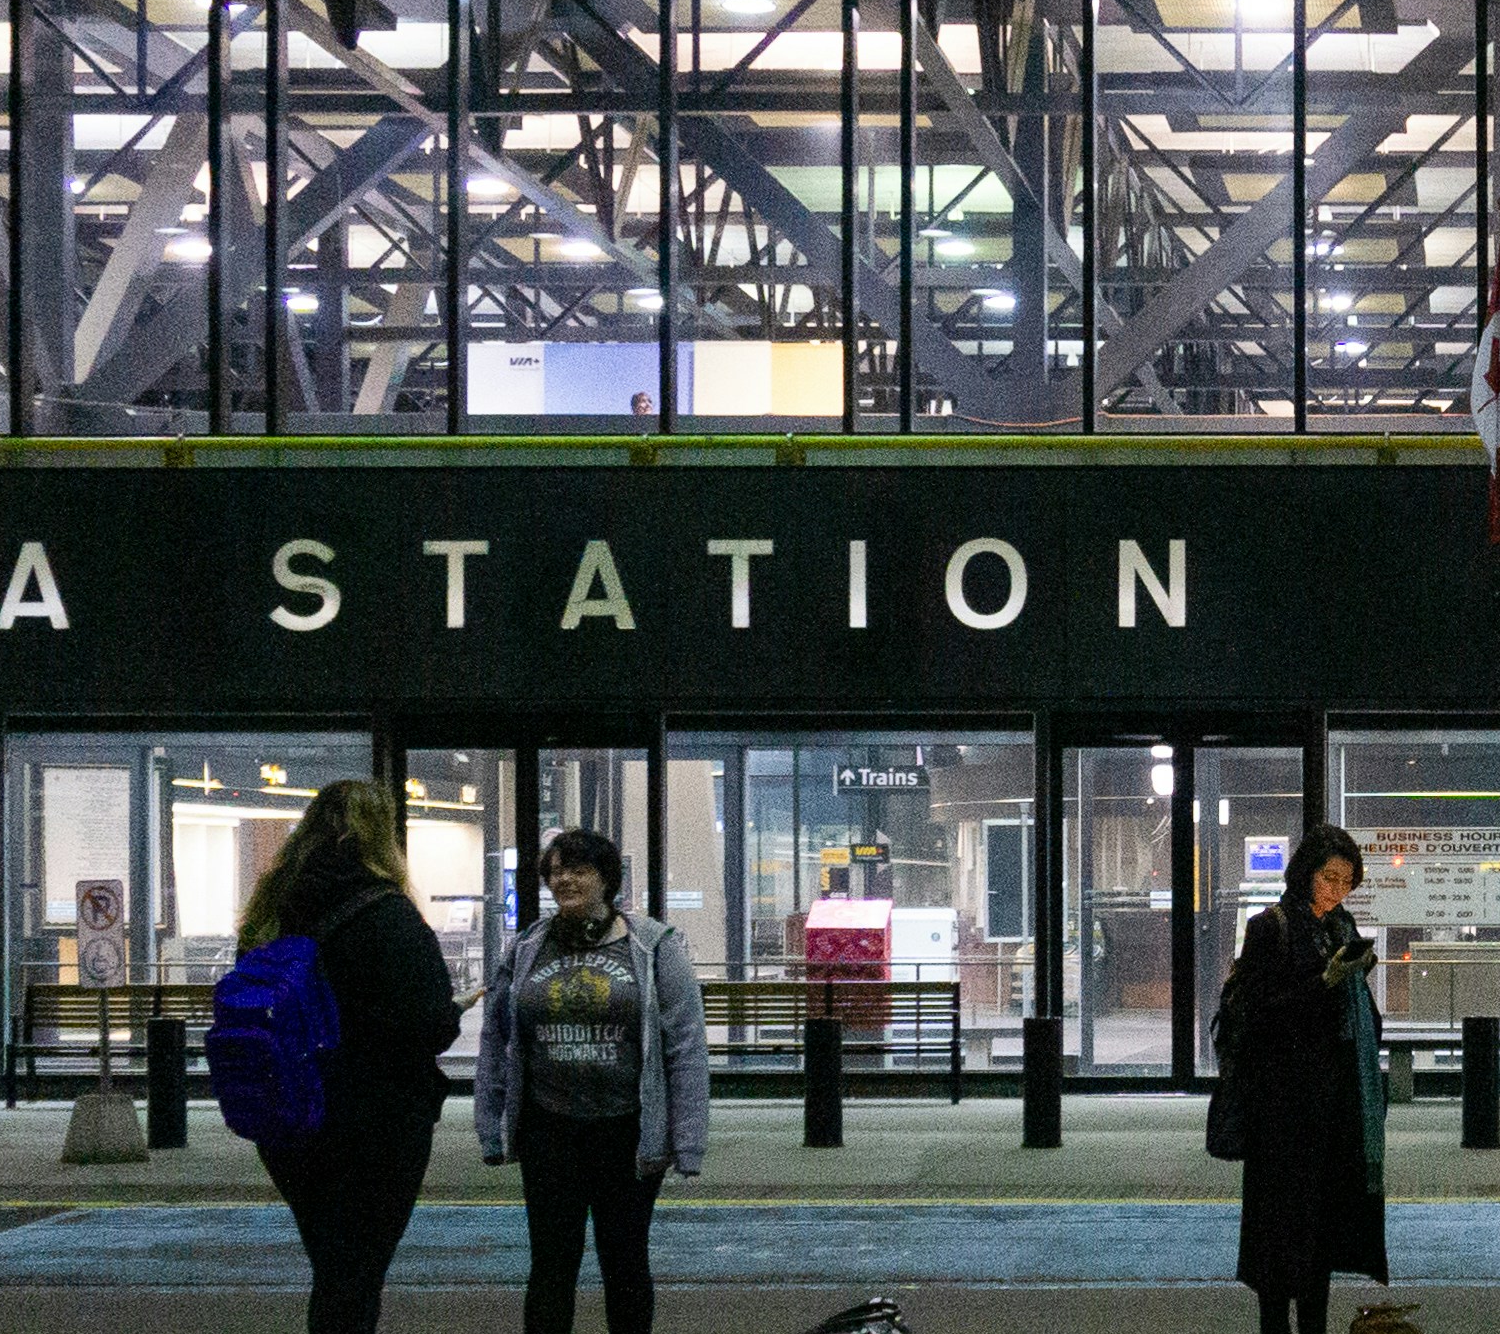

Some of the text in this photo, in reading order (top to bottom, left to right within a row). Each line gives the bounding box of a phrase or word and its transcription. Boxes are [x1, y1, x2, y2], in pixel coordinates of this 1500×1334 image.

[269, 538, 1188, 632] STATION
[858, 768, 918, 786] Trains
[1376, 831, 1453, 842] BUSINESS
[1358, 843, 1419, 853] HEURES
